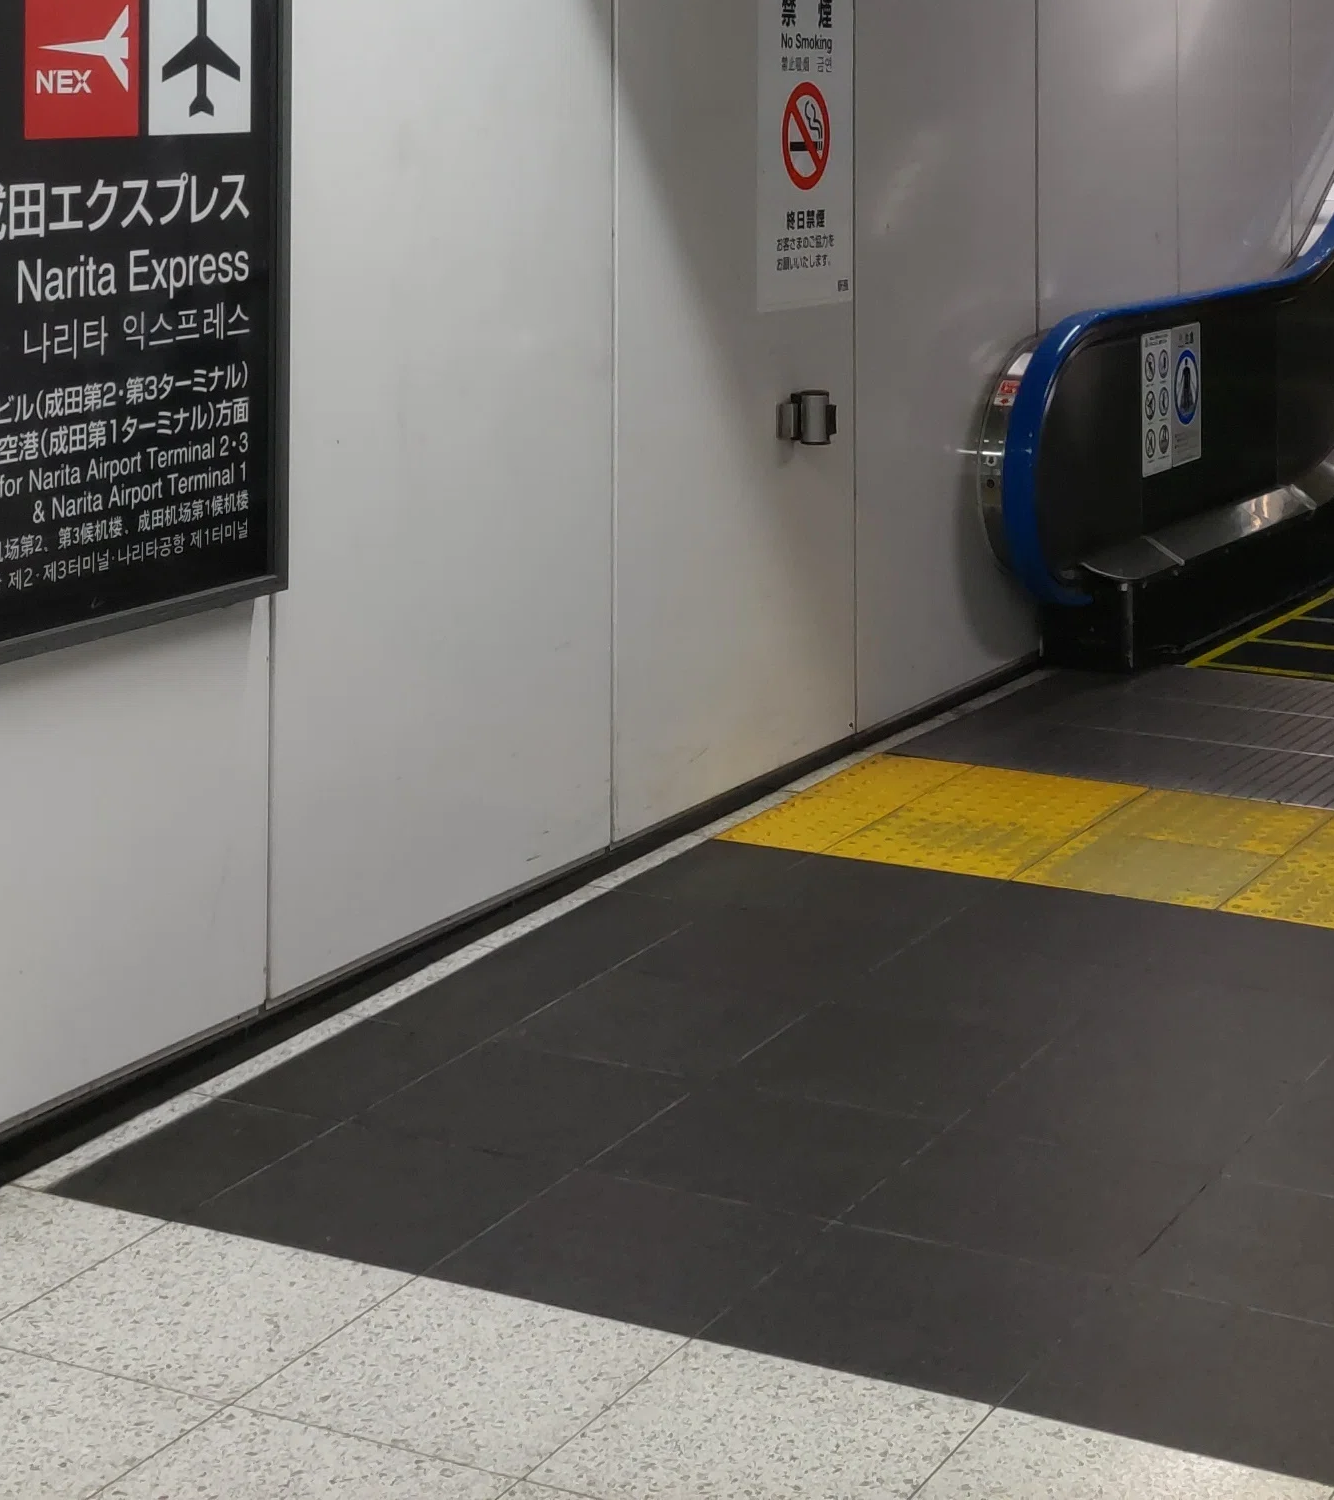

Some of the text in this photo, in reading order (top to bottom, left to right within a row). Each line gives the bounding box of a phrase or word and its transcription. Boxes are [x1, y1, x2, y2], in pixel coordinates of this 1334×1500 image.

[781, 33, 833, 54] No Smoking
[18, 249, 249, 303] Narita Express
[24, 316, 108, 363] 나리타
[124, 303, 250, 350] 익스프레스
[0, 474, 23, 497] for
[29, 464, 81, 492] Narita
[86, 452, 141, 482] Airport
[147, 438, 214, 469] Terminal
[33, 461, 245, 523] & Narita Airport Terminal 1
[190, 518, 247, 548] 제1터미널
